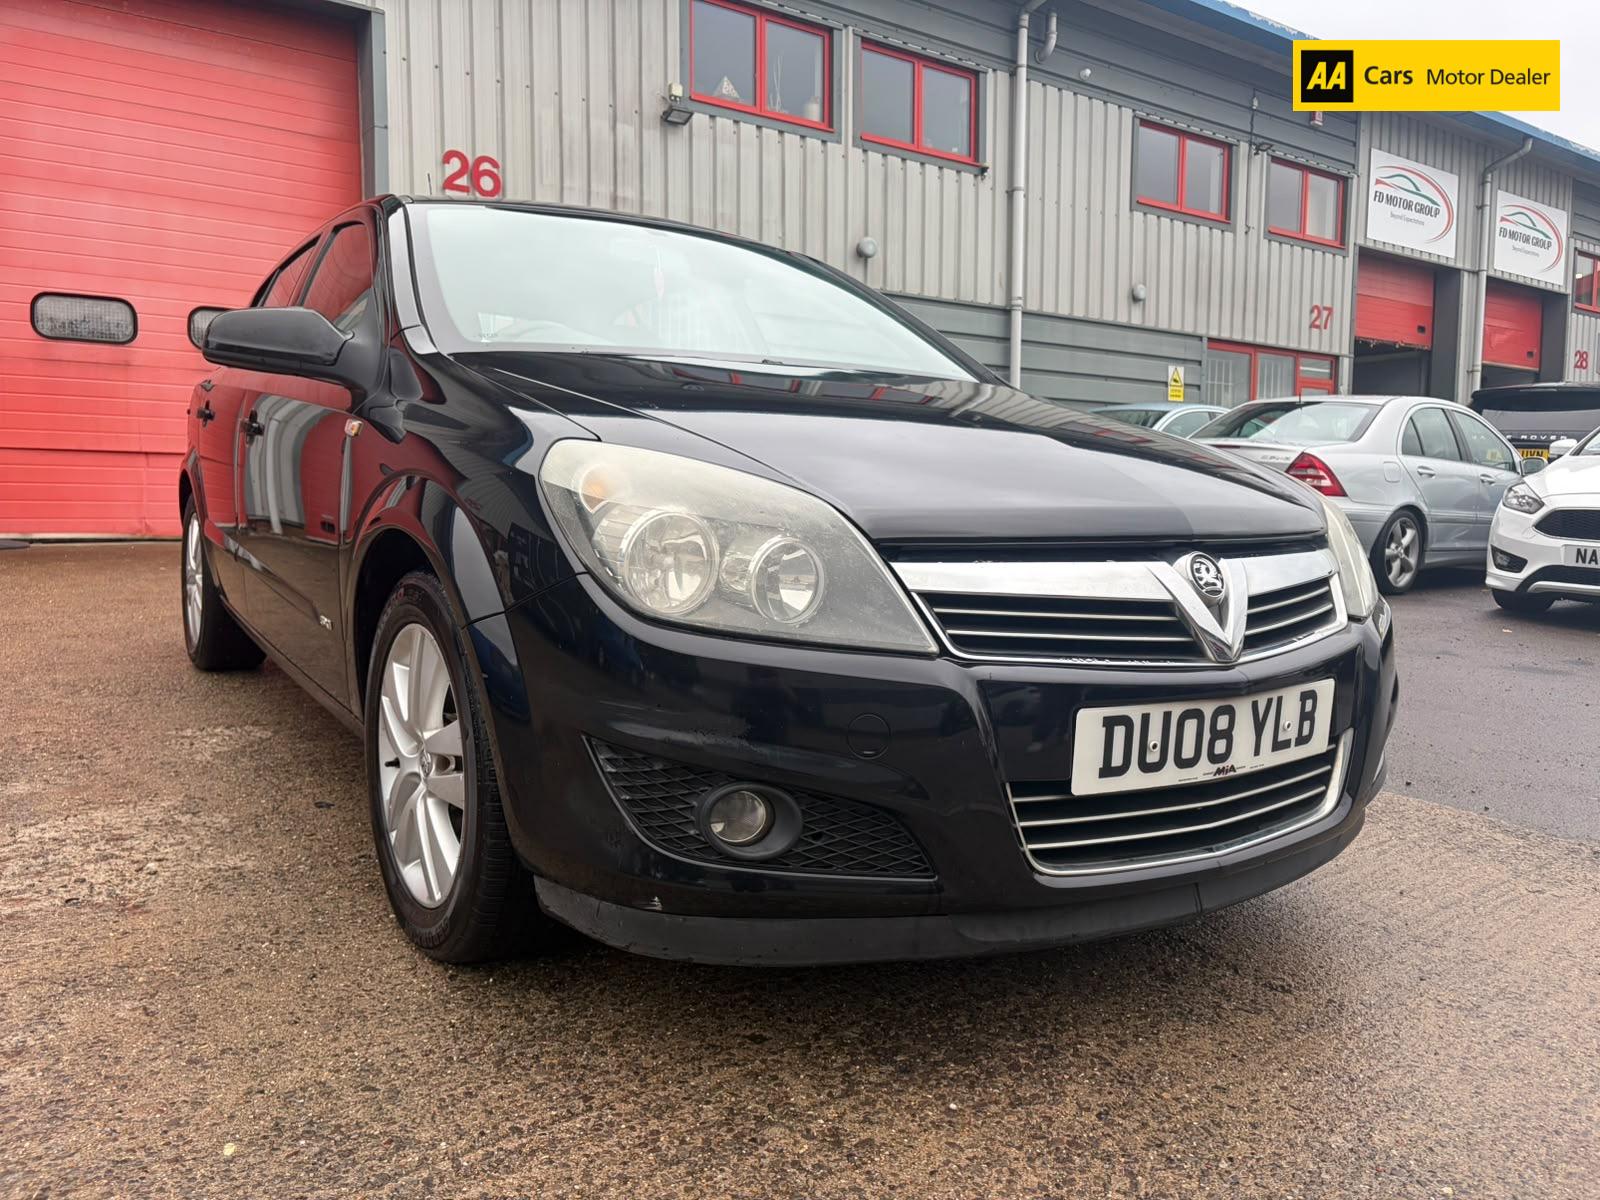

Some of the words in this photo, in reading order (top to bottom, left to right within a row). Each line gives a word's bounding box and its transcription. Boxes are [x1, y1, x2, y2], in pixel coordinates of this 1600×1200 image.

[441, 149, 502, 198] 26
[1373, 190, 1385, 203] FD
[1385, 193, 1414, 212] MOTOR
[1414, 202, 1441, 218] GROUP
[1498, 226, 1508, 238] FD
[1508, 229, 1531, 245] MOTOR
[1531, 236, 1552, 250] GROUP
[1309, 304, 1335, 330] 27
[1574, 350, 1588, 369] 28
[1575, 548, 1598, 565] NA
[1098, 704, 1236, 779] DU08
[1251, 688, 1318, 757] YLB
